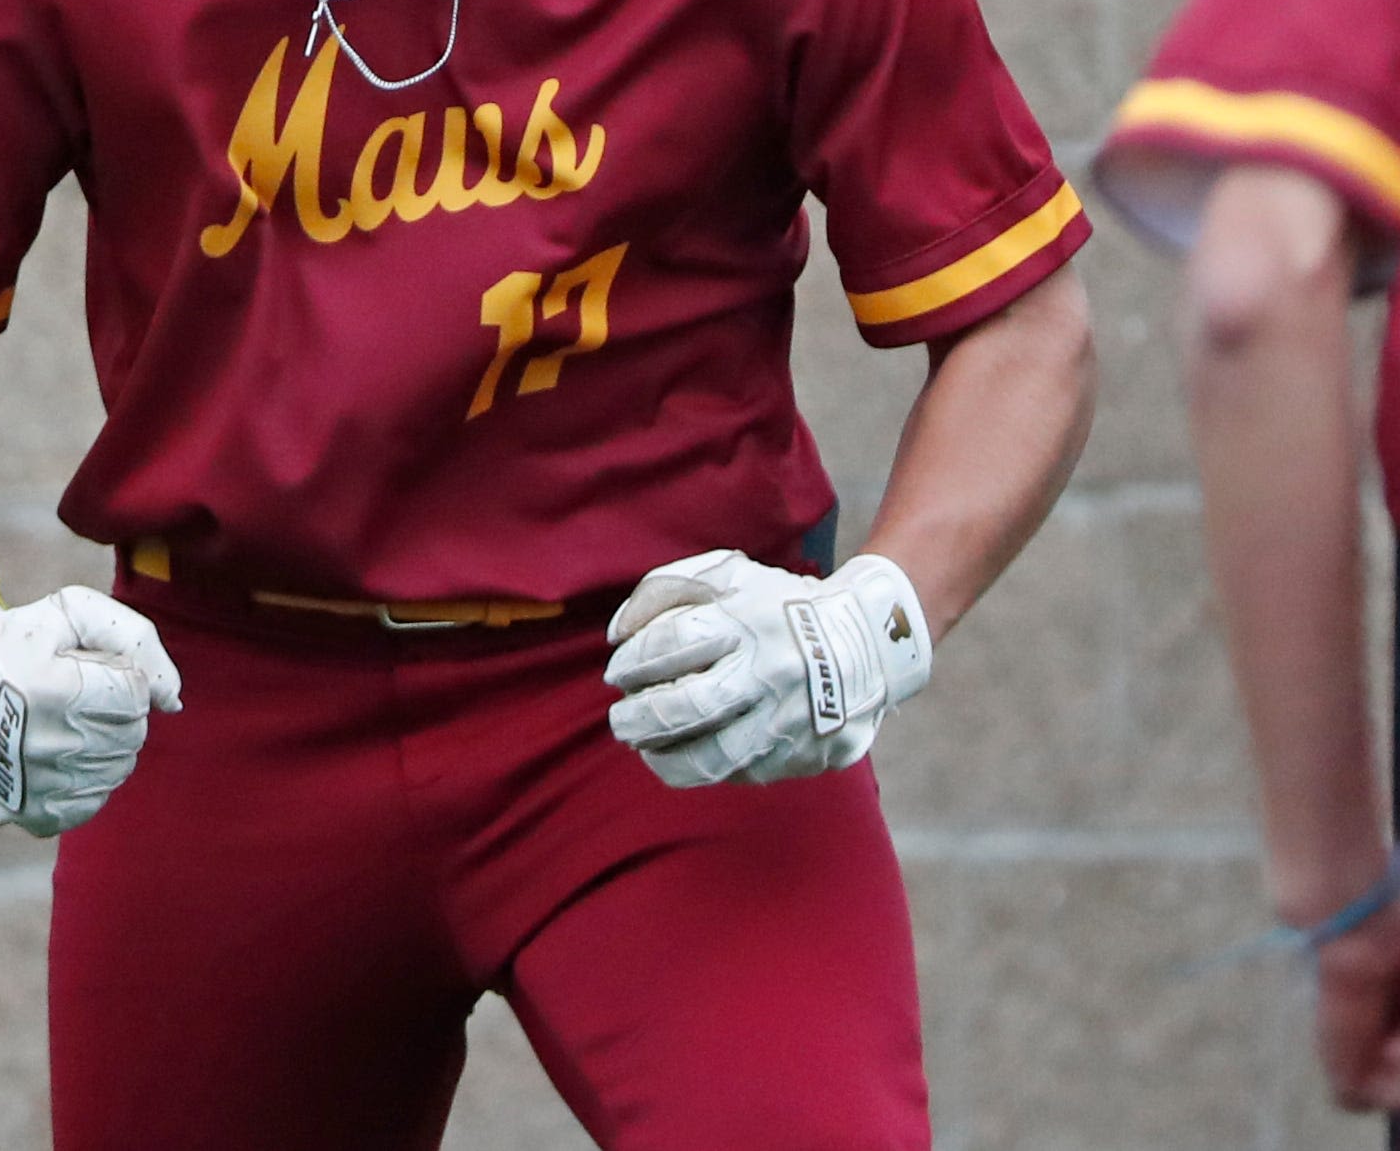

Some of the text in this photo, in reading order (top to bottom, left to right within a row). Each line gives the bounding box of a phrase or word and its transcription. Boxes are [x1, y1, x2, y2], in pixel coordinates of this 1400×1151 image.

[200, 23, 606, 258] Mavs
[465, 242, 629, 422] 17
[798, 606, 841, 722] Franklin
